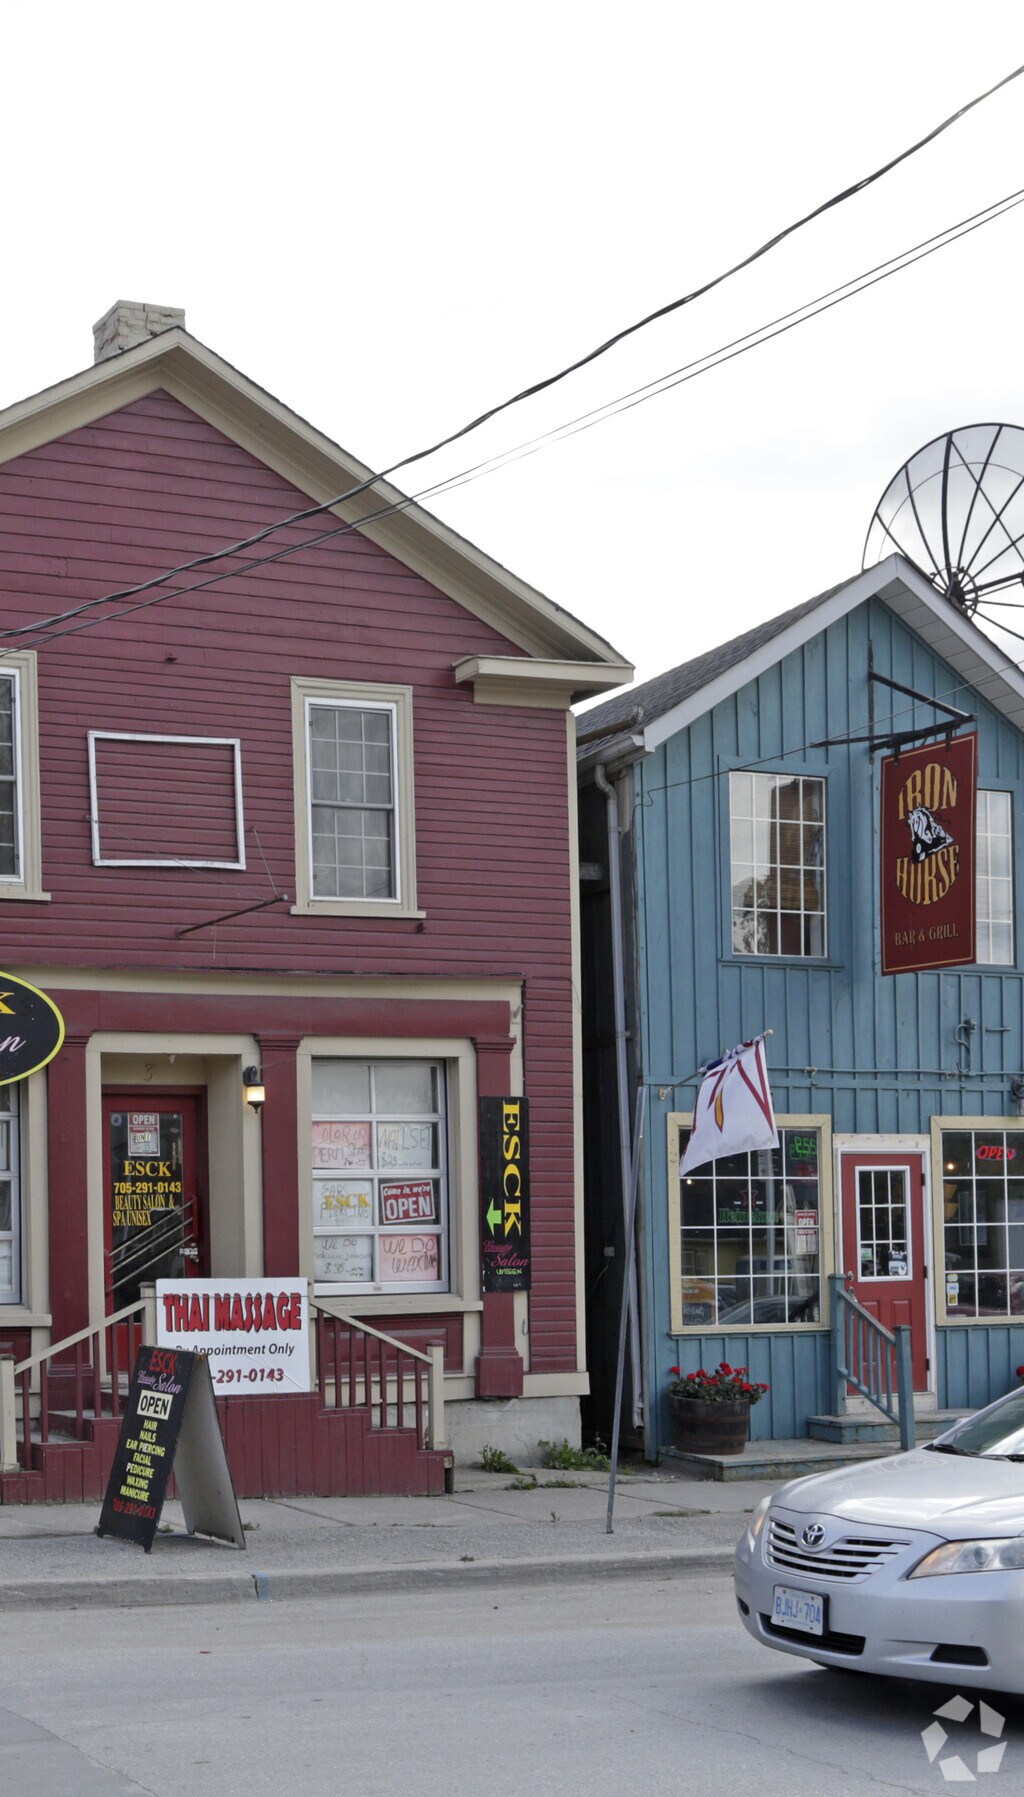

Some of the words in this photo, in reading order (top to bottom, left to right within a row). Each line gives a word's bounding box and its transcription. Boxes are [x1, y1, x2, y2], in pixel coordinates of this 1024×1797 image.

[898, 763, 958, 820] IRON
[896, 845, 960, 905] HORSE
[895, 930, 915, 946] BAR
[919, 928, 926, 941] &
[929, 923, 959, 941] GRILL
[133, 1114, 154, 1125] OPEN
[977, 1145, 1016, 1160] OPEN
[124, 1160, 171, 1177] ESCK
[503, 1100, 521, 1238] ESCK
[114, 1182, 181, 1193] 705-291-0143
[384, 1187, 401, 1196] Come
[413, 1184, 431, 1193] we're
[115, 1195, 142, 1210] BEAUTY
[142, 1194, 165, 1209] SALON
[169, 1194, 175, 1209] &
[386, 1196, 431, 1219] OPEN
[113, 1210, 125, 1226] SPA
[126, 1210, 151, 1226] UNISEX
[491, 1253, 528, 1267] Salon
[163, 1293, 210, 1333] THAI
[214, 1292, 301, 1333] MASSAGE
[192, 1344, 266, 1356] Appointment
[268, 1342, 295, 1357] Only
[150, 1350, 178, 1375] ESCK
[153, 1373, 182, 1394] Salon
[140, 1395, 170, 1416] OPEN
[143, 1419, 158, 1431] HAIR
[139, 1430, 156, 1442] NAILS
[126, 1438, 138, 1450] EAR
[138, 1443, 166, 1457] PIERCING
[133, 1452, 152, 1466] FACIAL
[126, 1463, 155, 1478] PEDICURE
[127, 1475, 149, 1489] WAXING
[120, 1485, 150, 1502] MANICURE
[804, 1602, 821, 1625] 704
